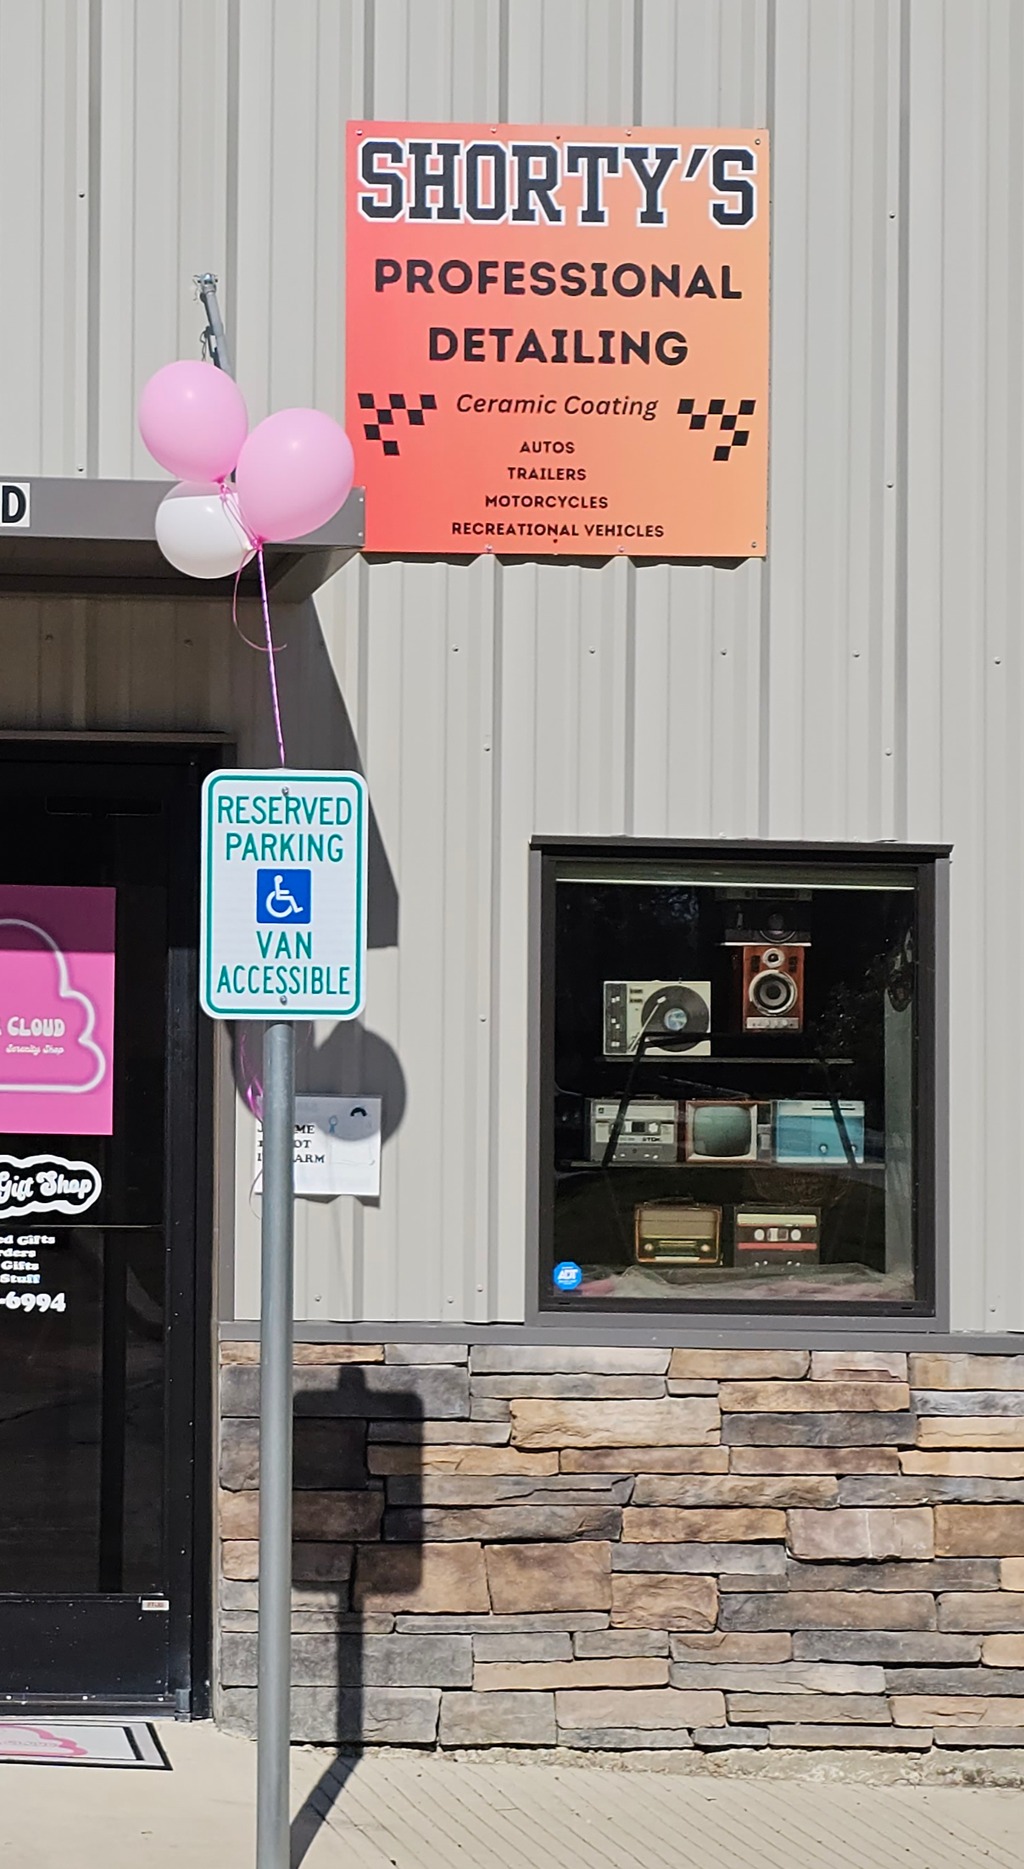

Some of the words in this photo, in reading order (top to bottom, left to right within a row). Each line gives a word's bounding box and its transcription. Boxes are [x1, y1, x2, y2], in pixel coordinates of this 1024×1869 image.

[357, 137, 758, 229] SHORTY'S
[374, 258, 742, 300] PROFESSIONAL
[428, 327, 688, 366] DETAILING
[456, 393, 557, 416] Ceramic
[563, 395, 659, 421] Coating
[519, 441, 575, 455] AUTOS
[507, 466, 587, 482] TRAILERS
[1, 485, 27, 524] D
[484, 494, 609, 510] MOTORCYCLES
[451, 521, 579, 538] RECREATIONAL
[584, 523, 665, 539] VEHICLES
[217, 795, 352, 825] RESERVED
[224, 832, 344, 863] PARKING
[255, 930, 312, 961] VAN
[216, 964, 351, 996] ACCESSIBLE
[7, 1016, 66, 1038] CLOUD
[42, 1043, 65, 1057] Shop
[36, 1170, 93, 1199] Shop
[16, 1235, 56, 1245] Gifts
[0, 1260, 39, 1271] Gifts
[558, 1269, 578, 1280] ADT
[0, 1274, 41, 1285] Stuff
